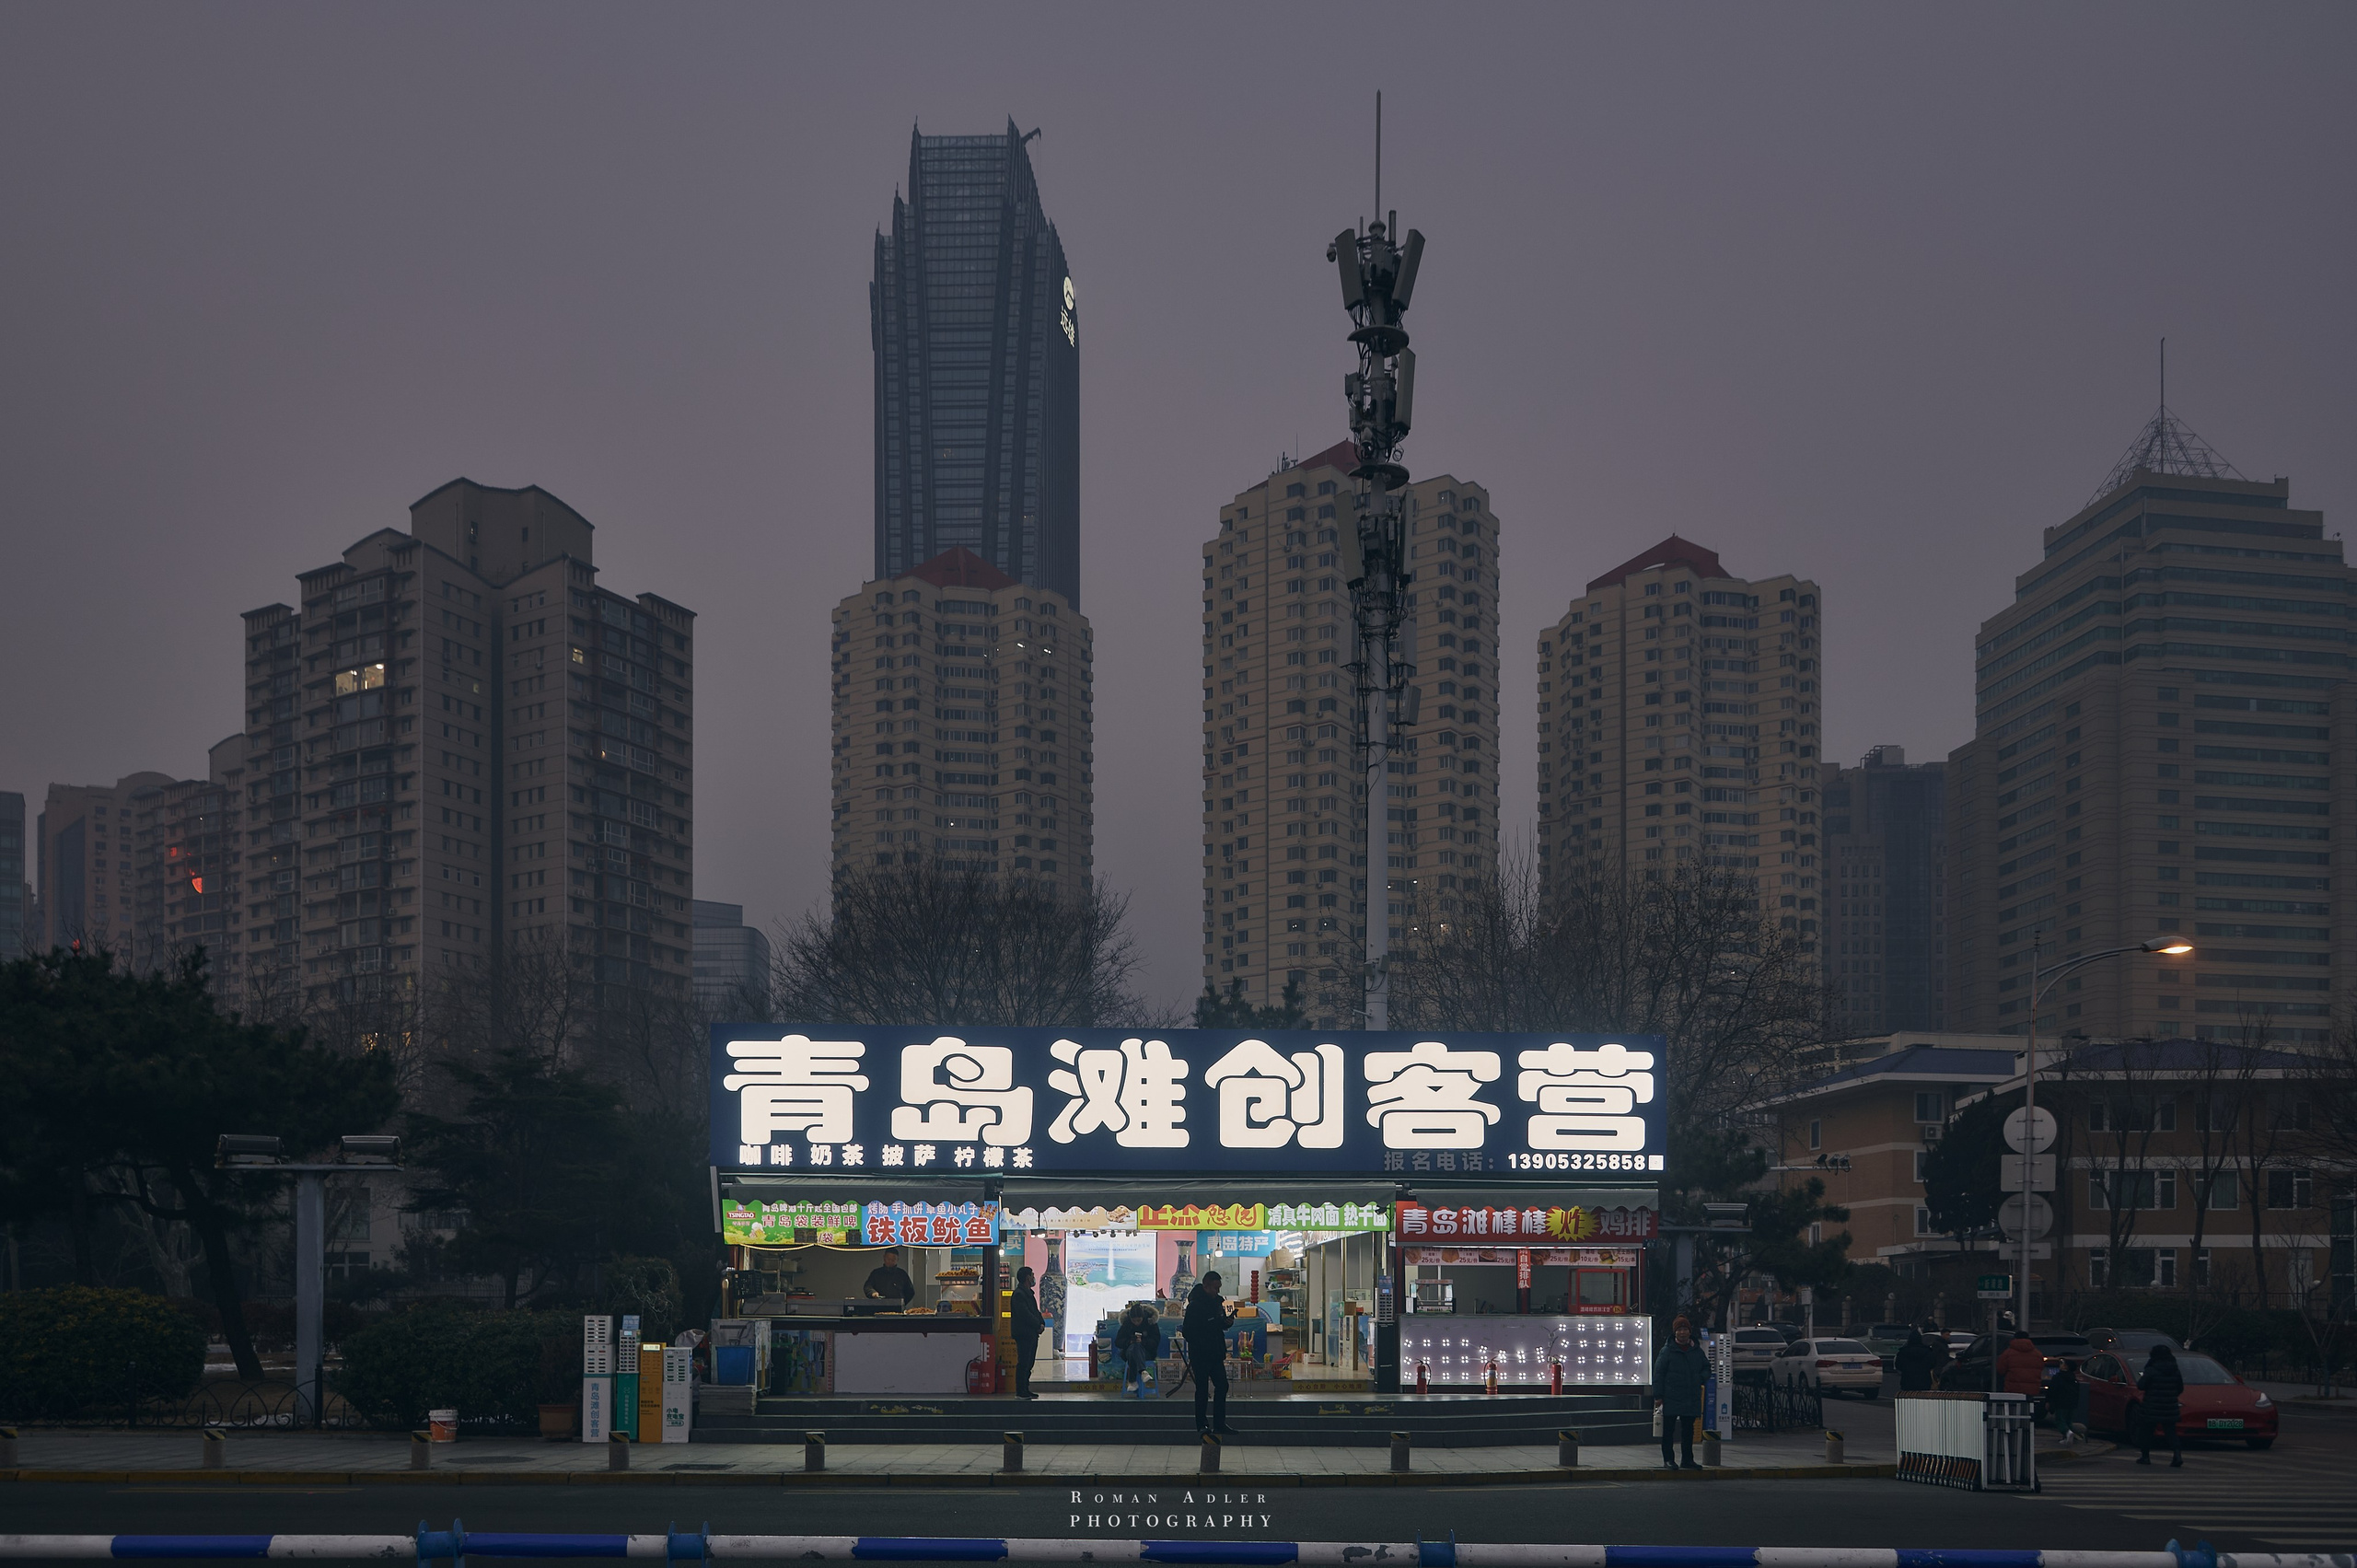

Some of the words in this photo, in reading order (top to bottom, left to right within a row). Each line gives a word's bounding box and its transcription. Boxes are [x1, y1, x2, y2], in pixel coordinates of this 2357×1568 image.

[723, 1034, 1655, 1151] 青岛滩创客营
[739, 1144, 793, 1167] 咖啡
[810, 1144, 865, 1167] 奶茶
[882, 1144, 936, 1167] 披萨
[954, 1145, 1034, 1168] 柠檬茶
[1507, 1153, 1646, 1171] 13905325858
[761, 1214, 858, 1228] 青岛袋装鲜啤
[866, 1214, 994, 1245] 铁板鱿鱼
[1207, 1235, 1270, 1252] 青岛特产
